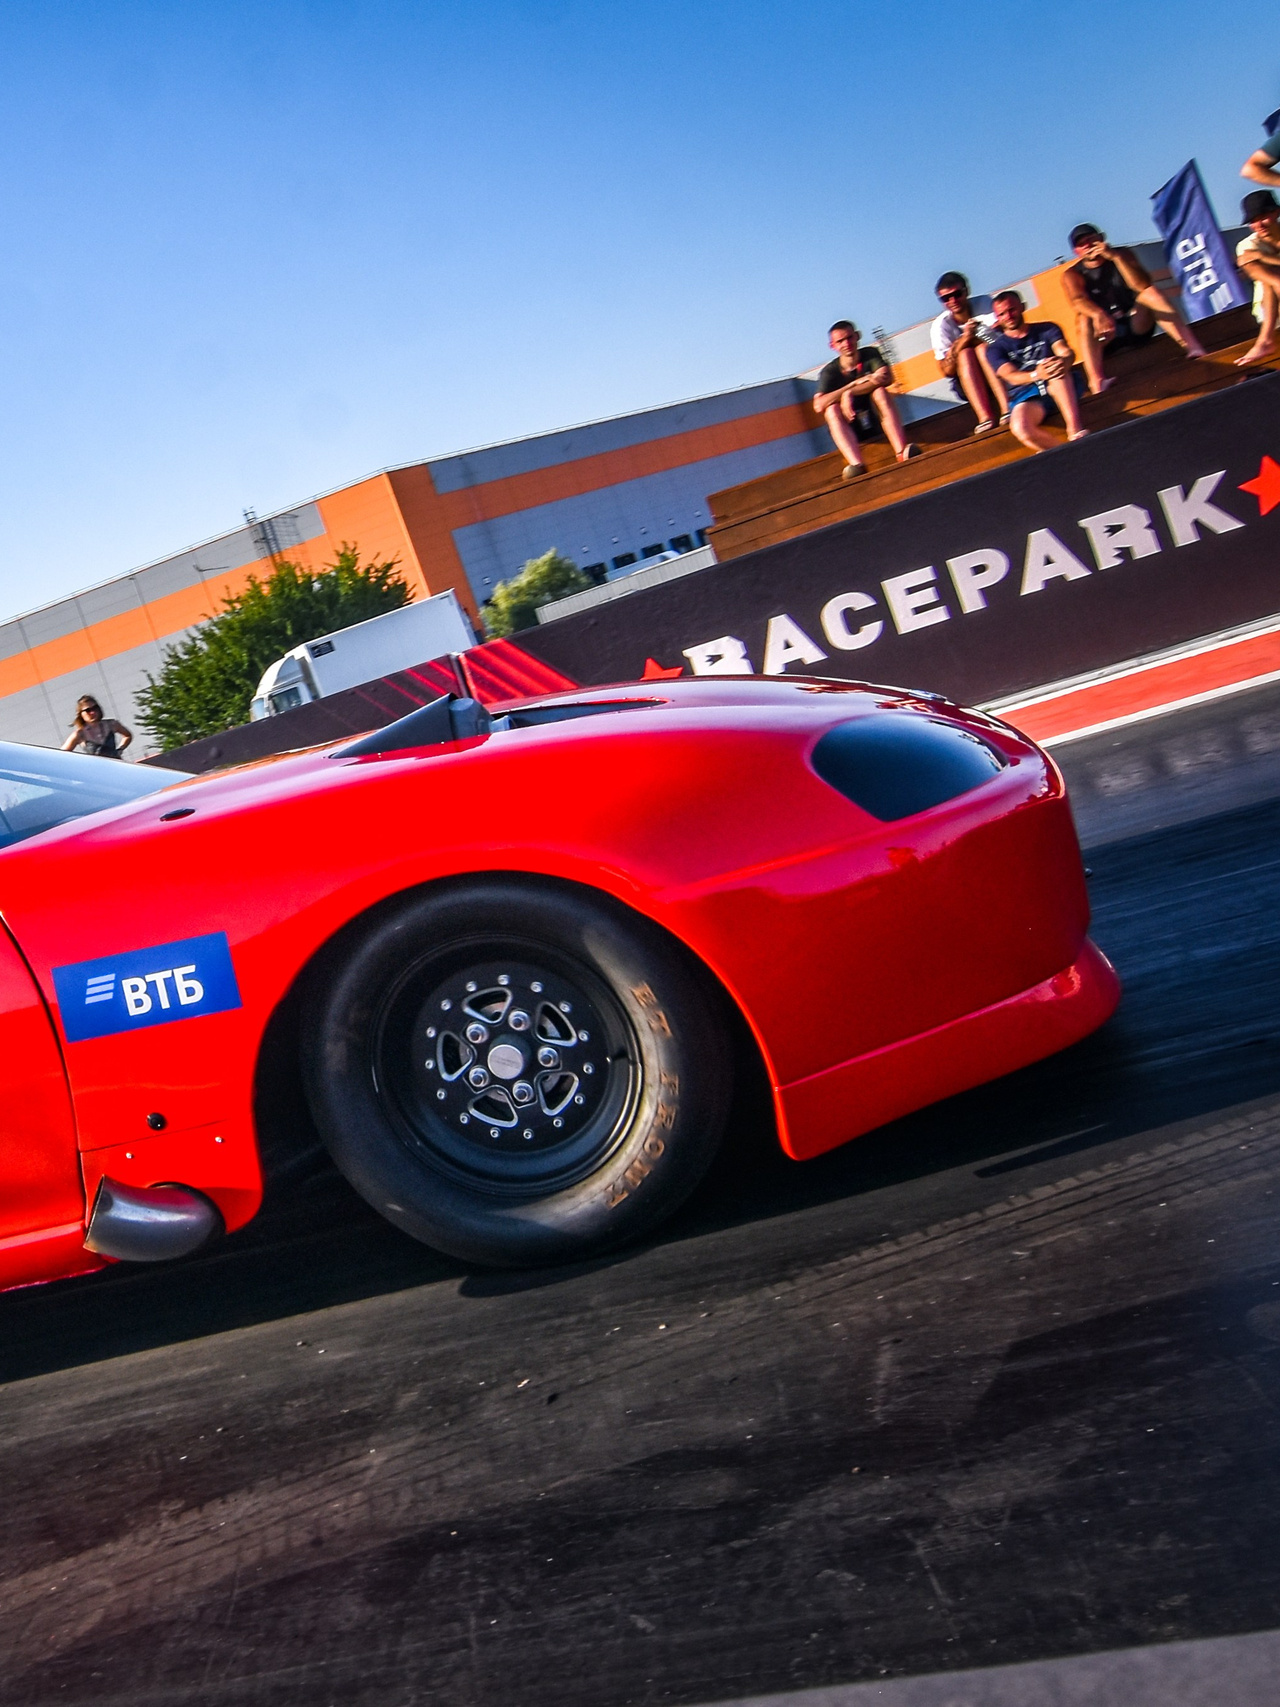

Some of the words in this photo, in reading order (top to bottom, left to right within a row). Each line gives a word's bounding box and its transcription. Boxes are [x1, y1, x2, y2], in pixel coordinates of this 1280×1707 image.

[683, 470, 1246, 675] RACEPARK
[121, 964, 205, 1017] ВТБ
[604, 1071, 680, 1210] FRONT
